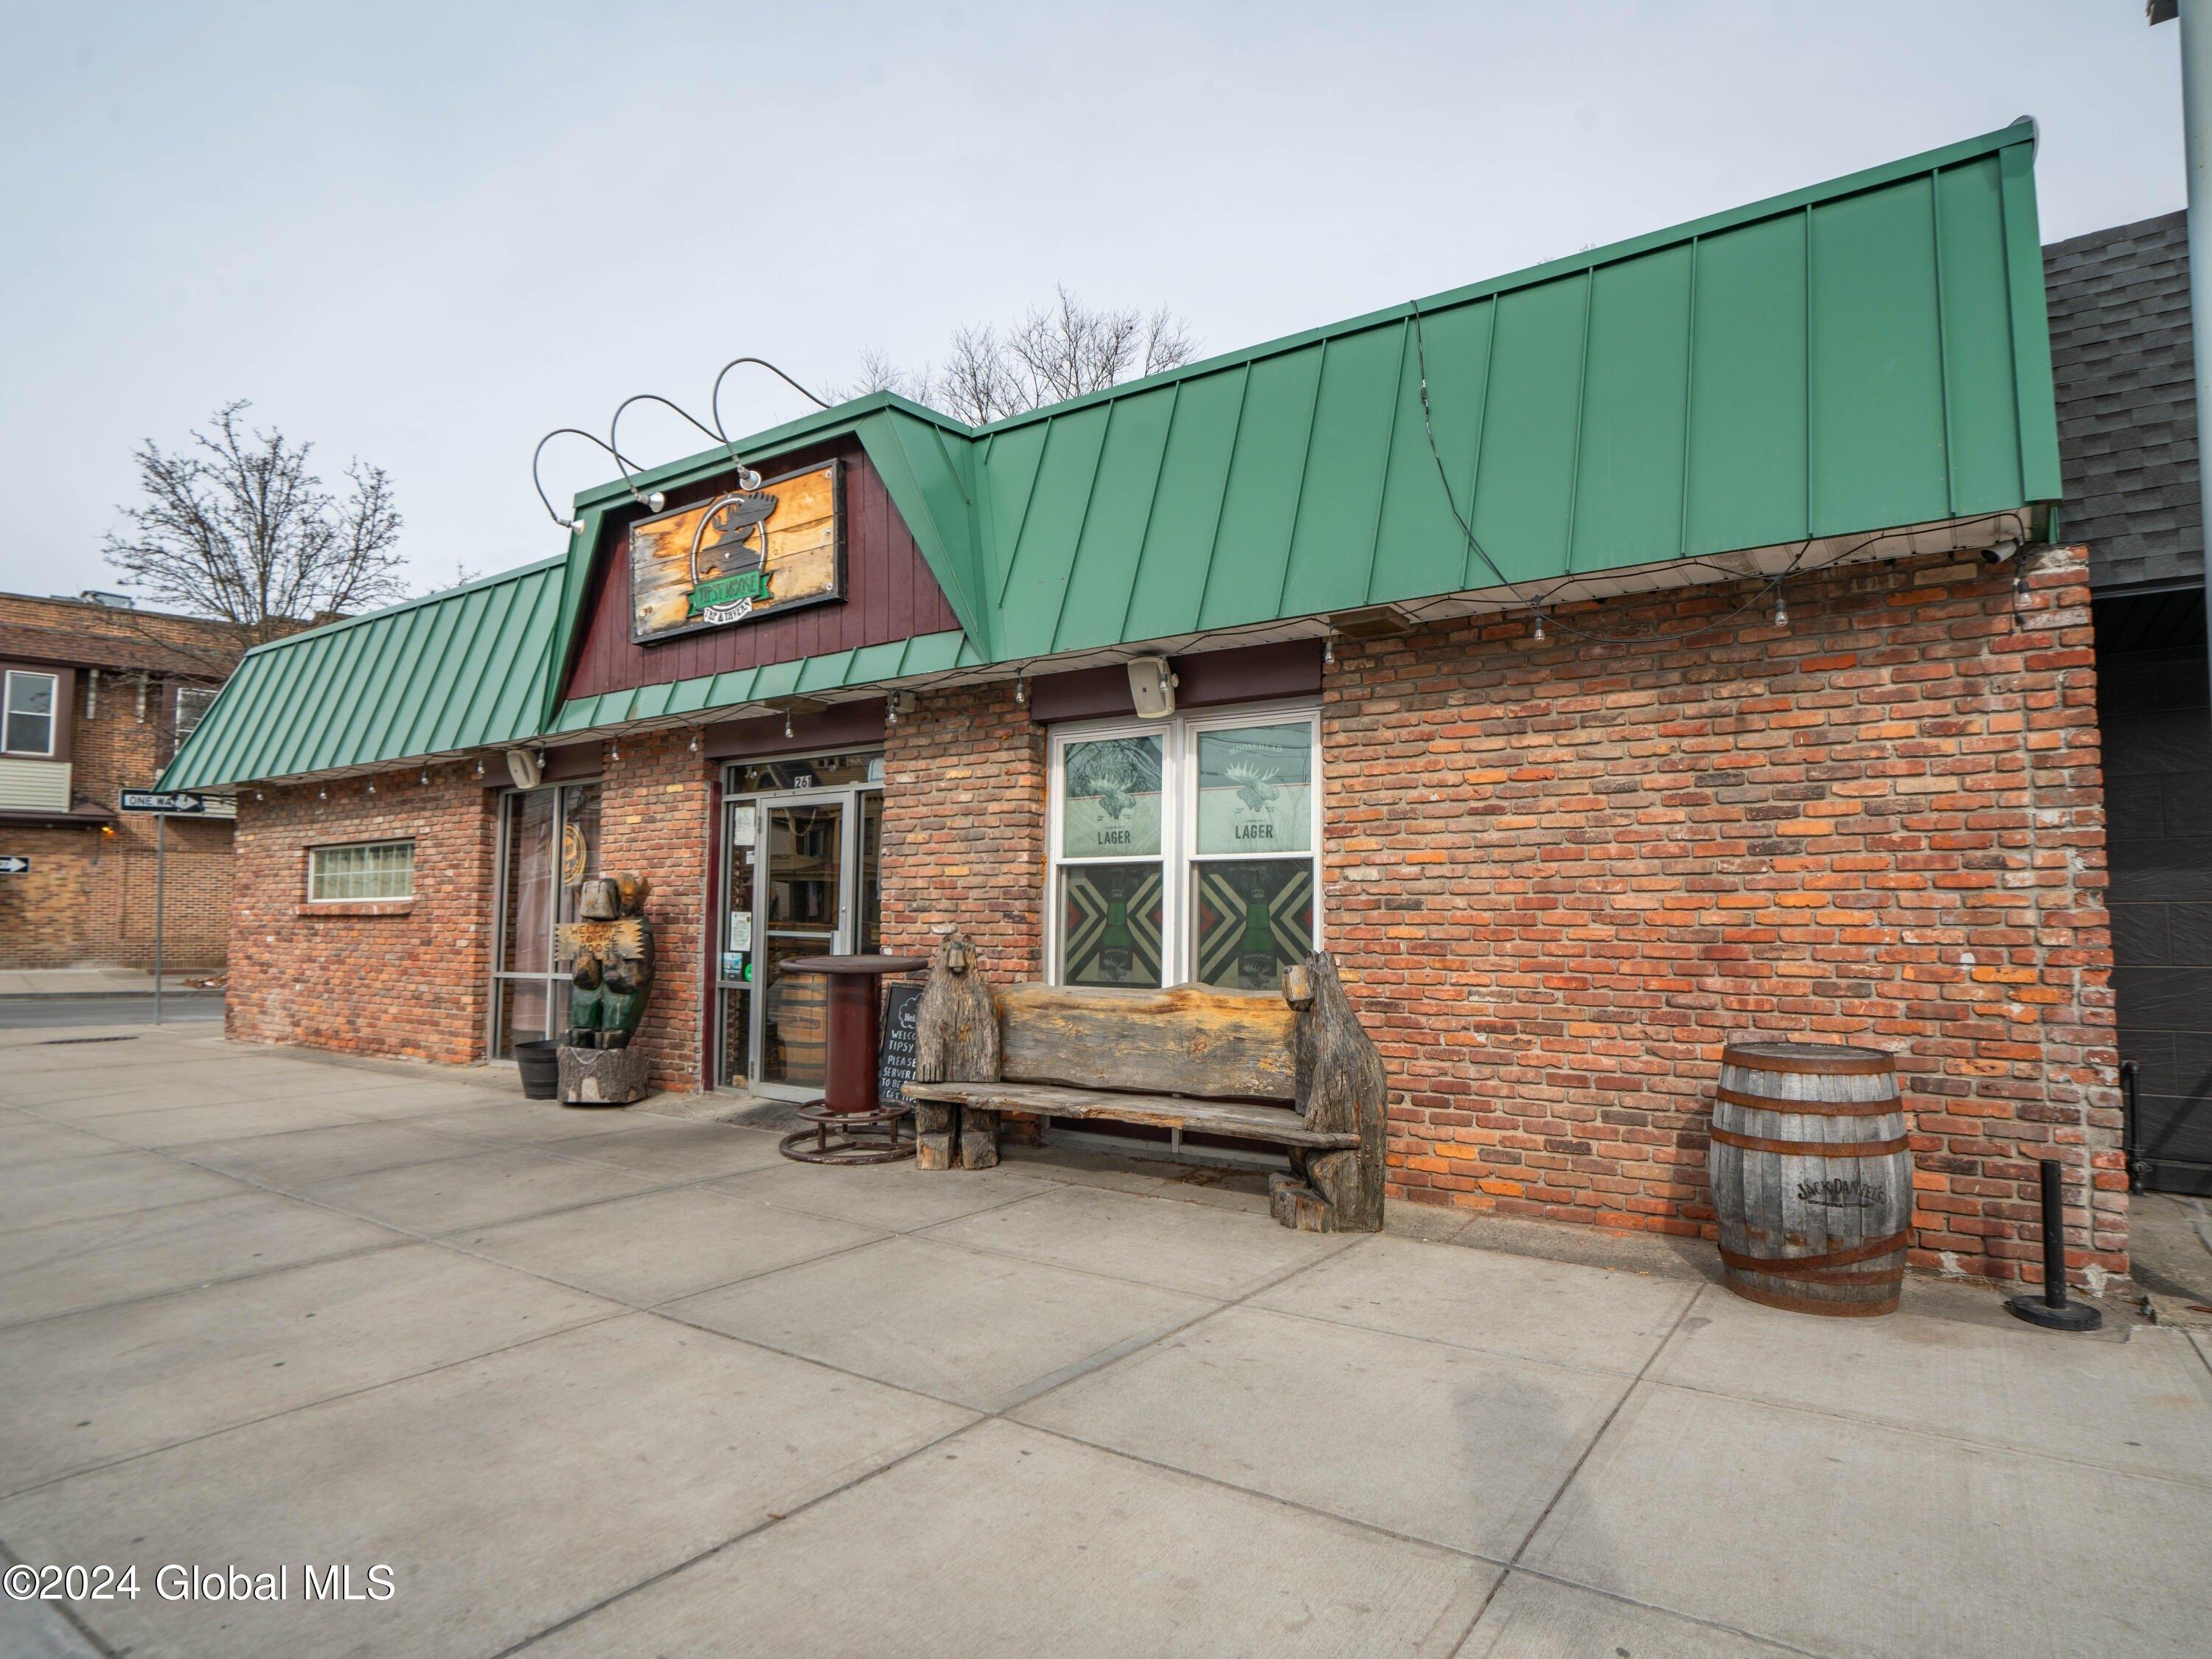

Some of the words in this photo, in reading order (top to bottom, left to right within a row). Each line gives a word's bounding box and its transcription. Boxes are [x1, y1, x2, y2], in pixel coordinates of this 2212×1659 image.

[699, 585, 723, 602] TIPSY
[726, 576, 756, 597] MOOSE
[724, 599, 751, 621] TAVERN
[796, 776, 811, 789] 261
[129, 796, 153, 805] ONE
[156, 797, 175, 806] WA
[1098, 830, 1130, 844] LAGER
[1235, 824, 1273, 839] LAGER
[571, 923, 624, 935] WELCOME
[579, 936, 593, 944] TO
[599, 934, 617, 942] THE
[580, 944, 619, 953] MOOSE
[889, 1040, 914, 1052] TIPSY
[888, 1055, 916, 1067] PLEASE
[883, 1066, 911, 1079] SERVER
[882, 1077, 890, 1087] TO
[892, 1079, 902, 1088] BE
[886, 1090, 900, 1099] GET
[1797, 1180, 1832, 1200] JACK
